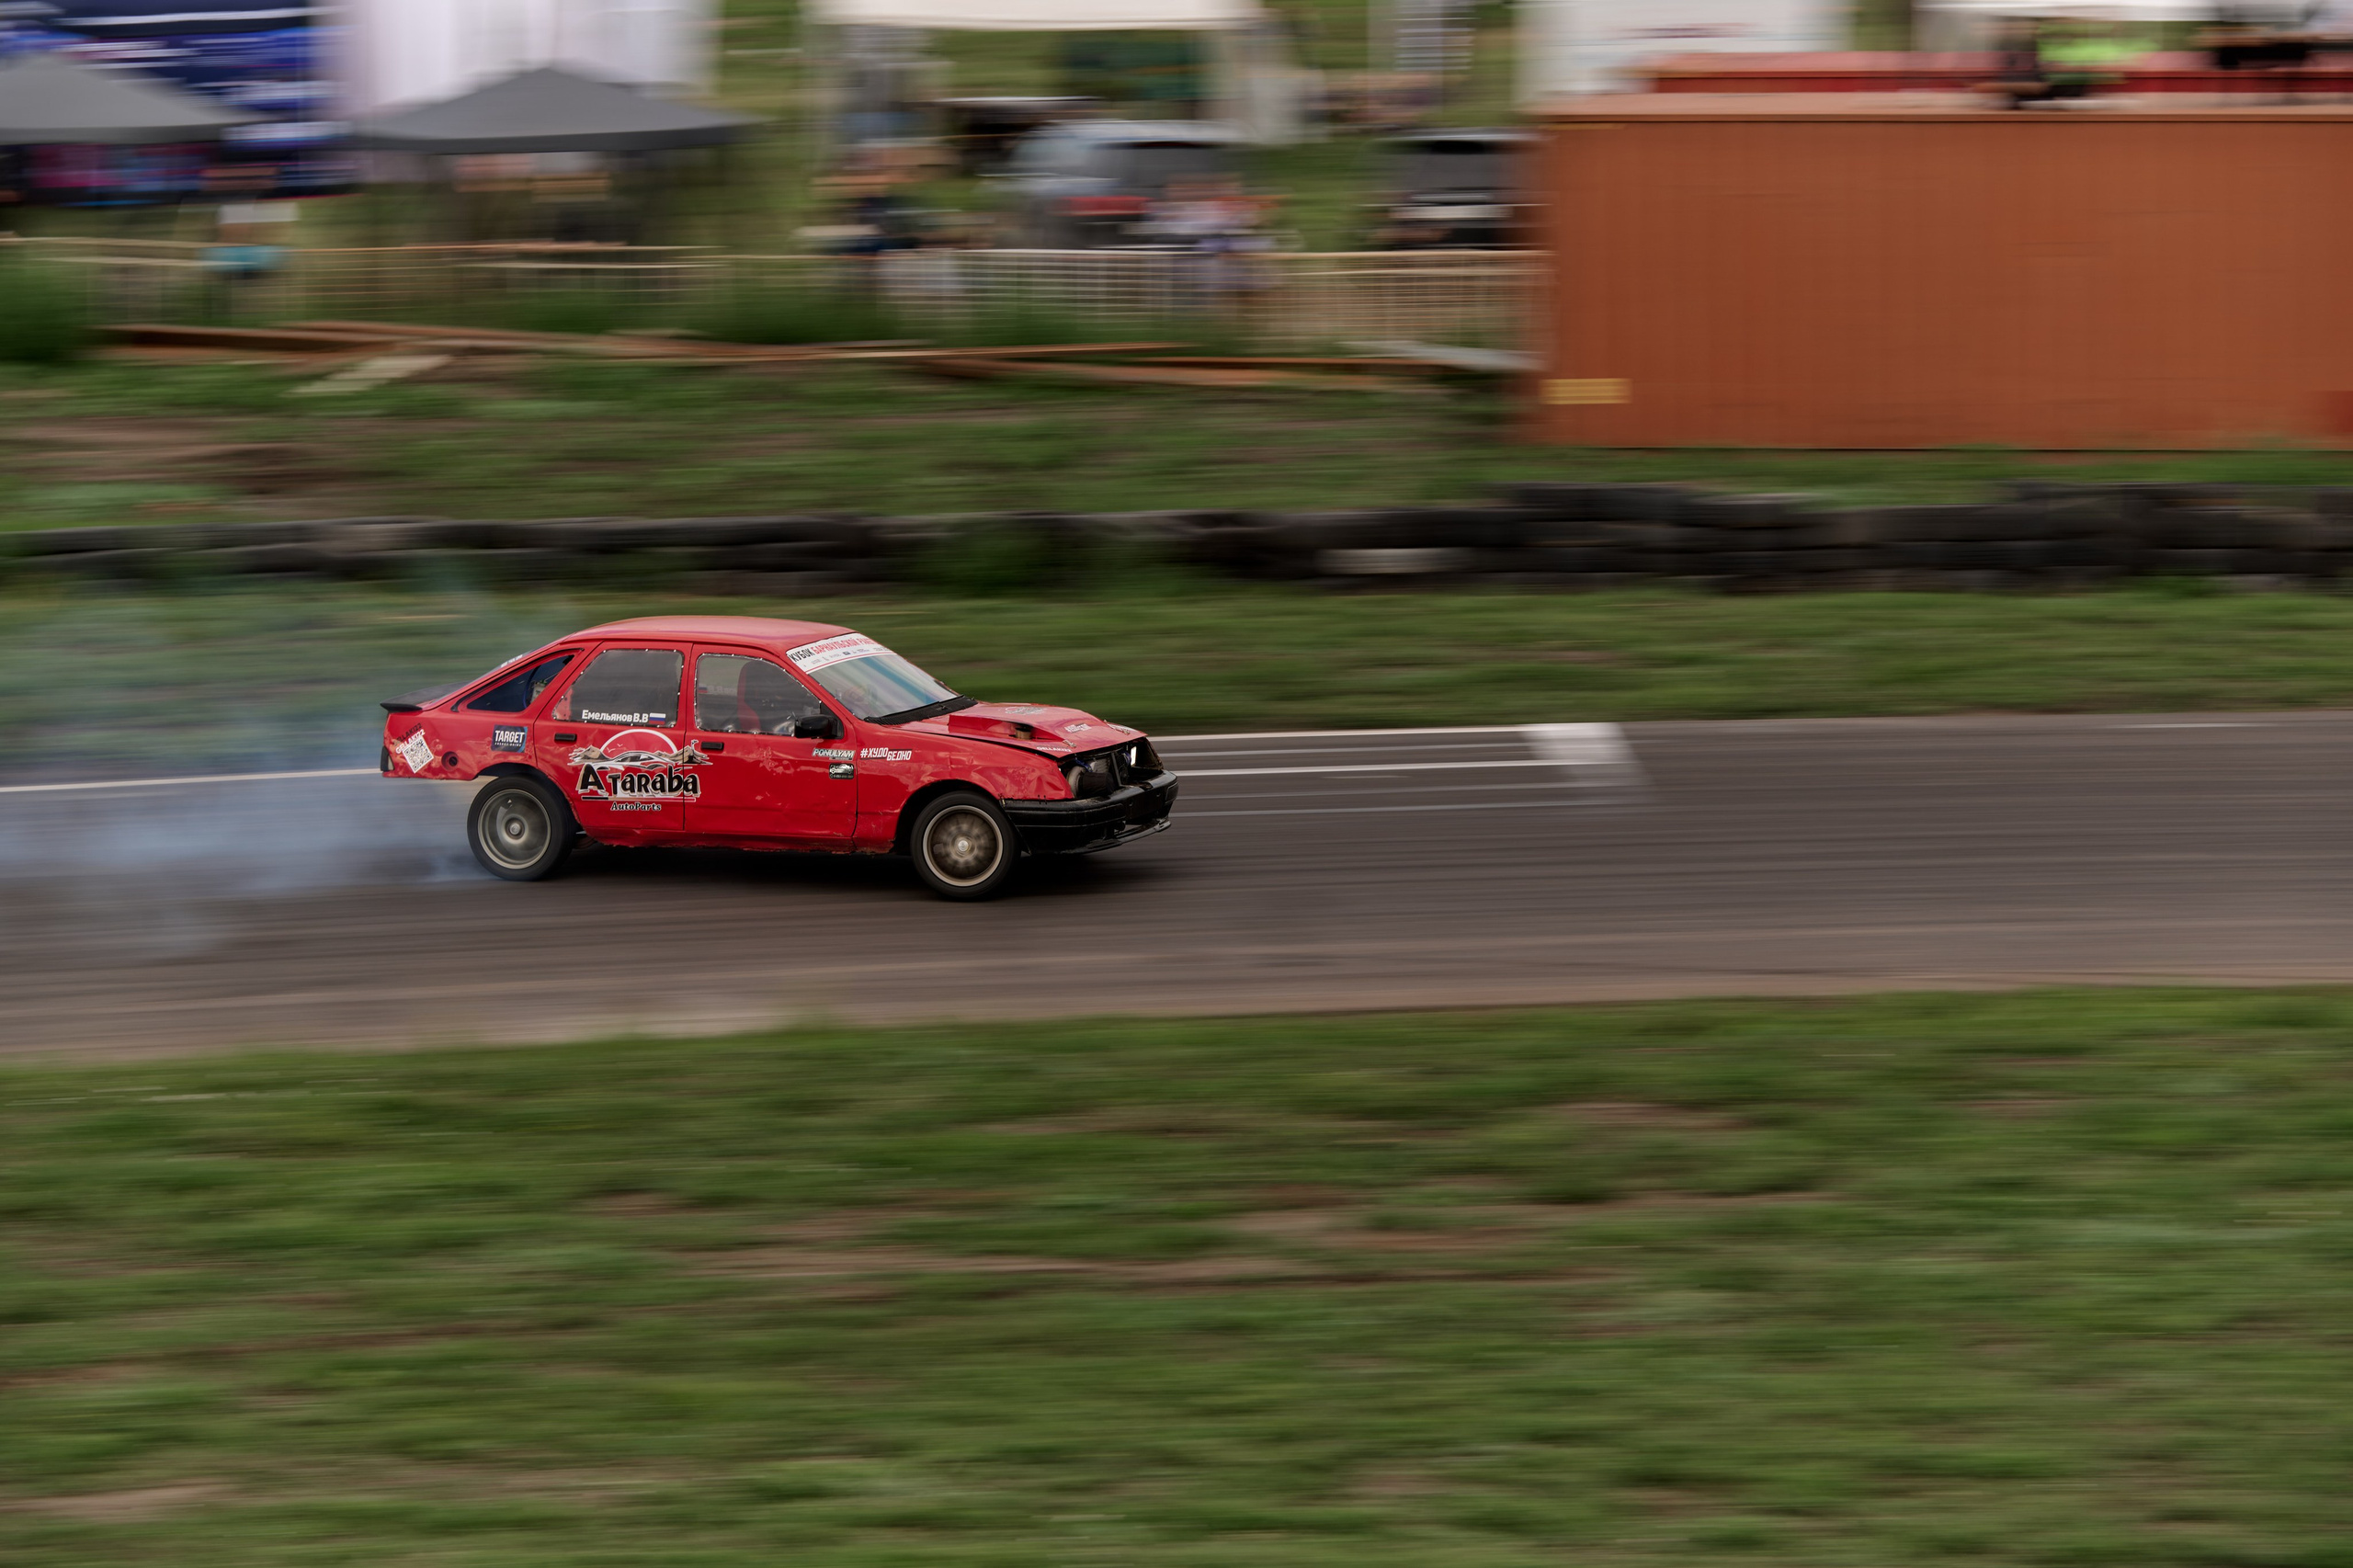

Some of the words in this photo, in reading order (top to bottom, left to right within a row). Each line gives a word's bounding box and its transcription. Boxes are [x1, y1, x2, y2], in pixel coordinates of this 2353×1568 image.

[789, 648, 815, 663] КУБОК
[582, 710, 632, 722] Емельянов
[395, 729, 426, 754] GELLAKI22
[494, 730, 525, 744] TARGET
[813, 747, 855, 758] PONULYAM
[610, 801, 662, 811] AutoParts
